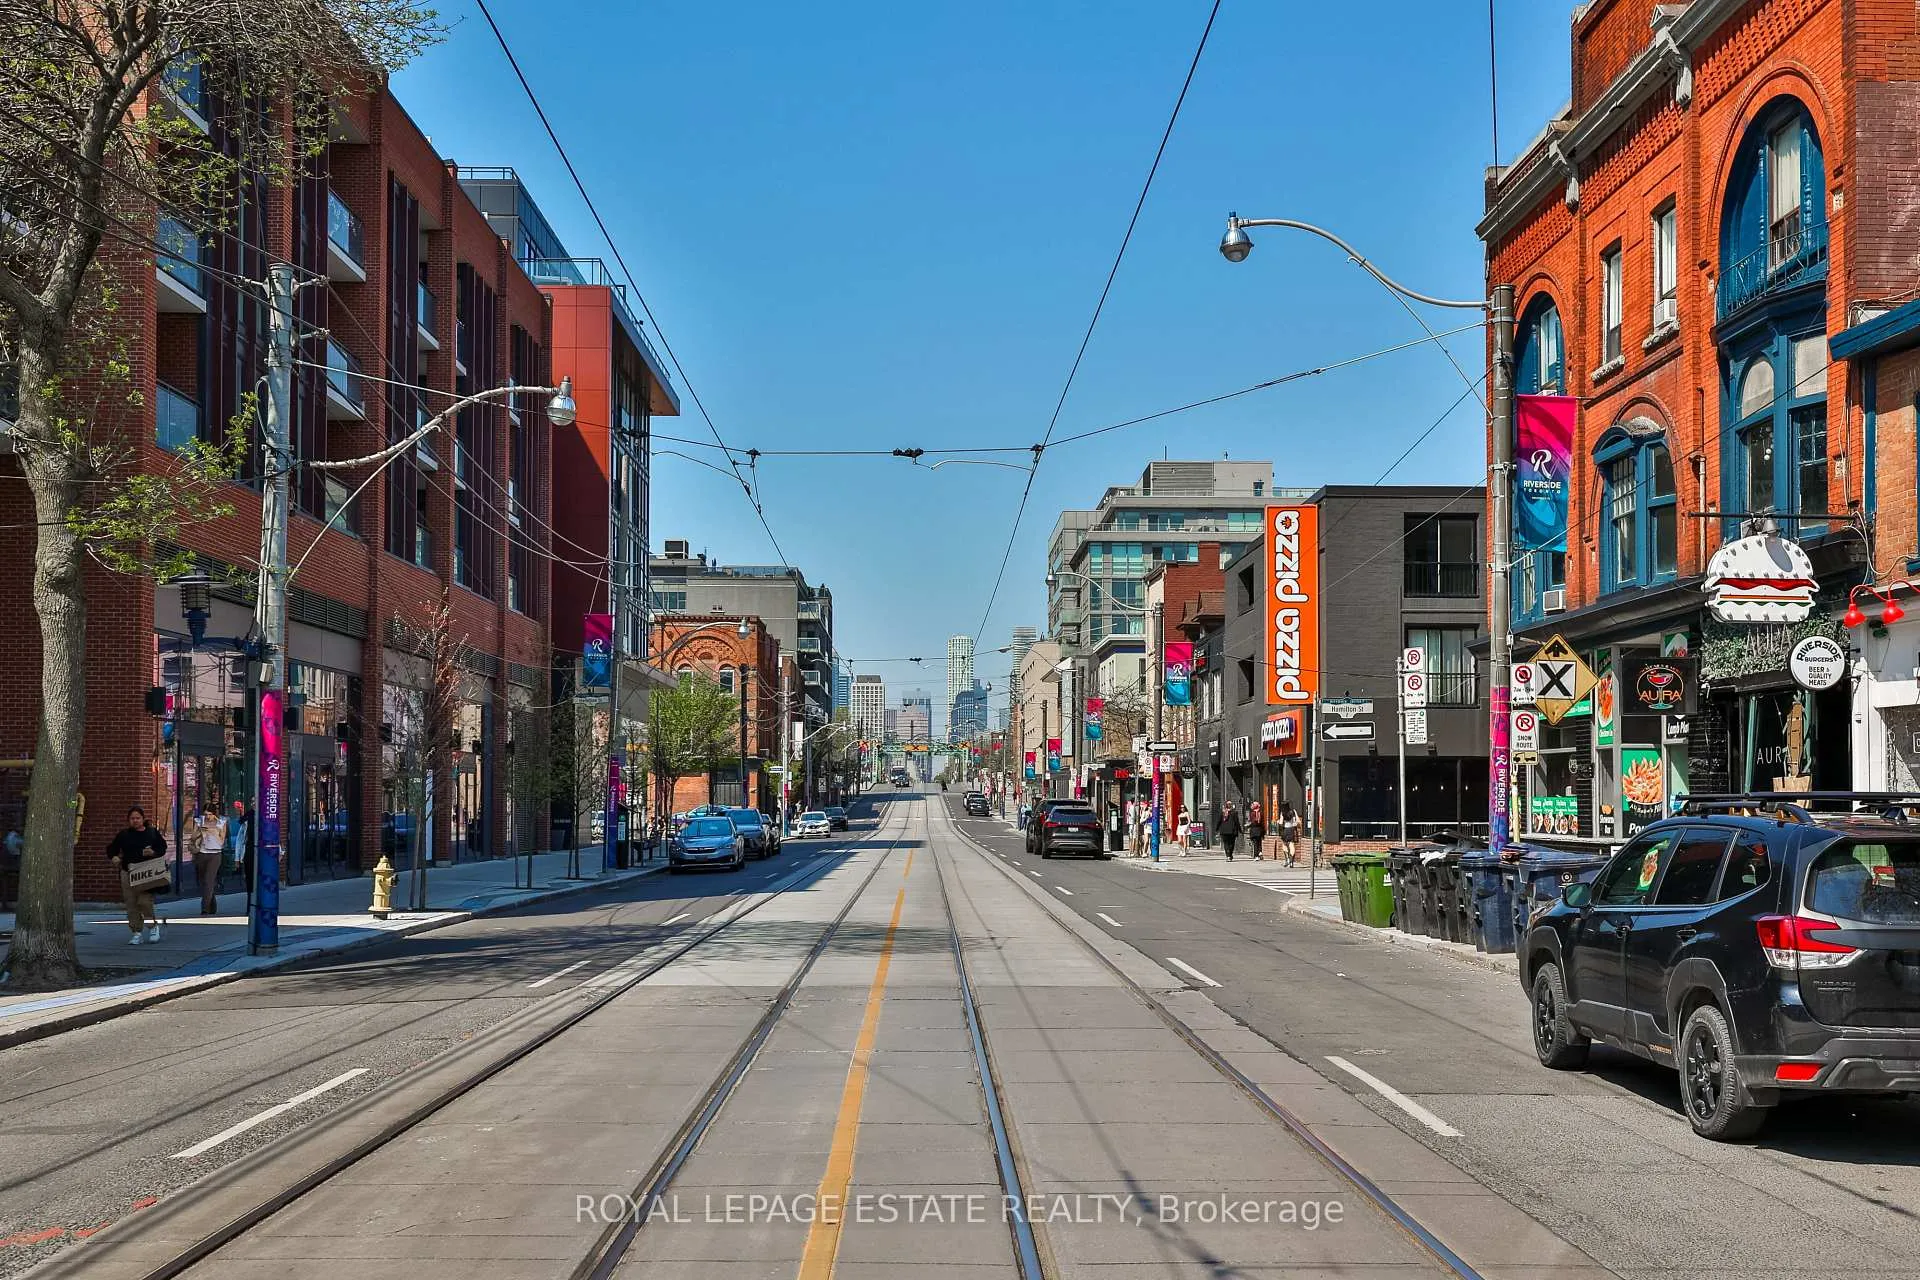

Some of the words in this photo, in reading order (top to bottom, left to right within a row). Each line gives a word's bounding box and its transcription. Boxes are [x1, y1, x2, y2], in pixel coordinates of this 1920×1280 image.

[1275, 510, 1309, 602] pizza
[1275, 608, 1309, 700] pizza
[1796, 640, 1842, 661] RIVERSIDE
[1808, 665, 1825, 673] BEER
[1639, 690, 1682, 701] AURA
[1756, 745, 1783, 765] AUR
[269, 773, 278, 819] RIVERSIDE
[1497, 768, 1506, 813] RIVERSIDE
[131, 870, 153, 883] NIKE
